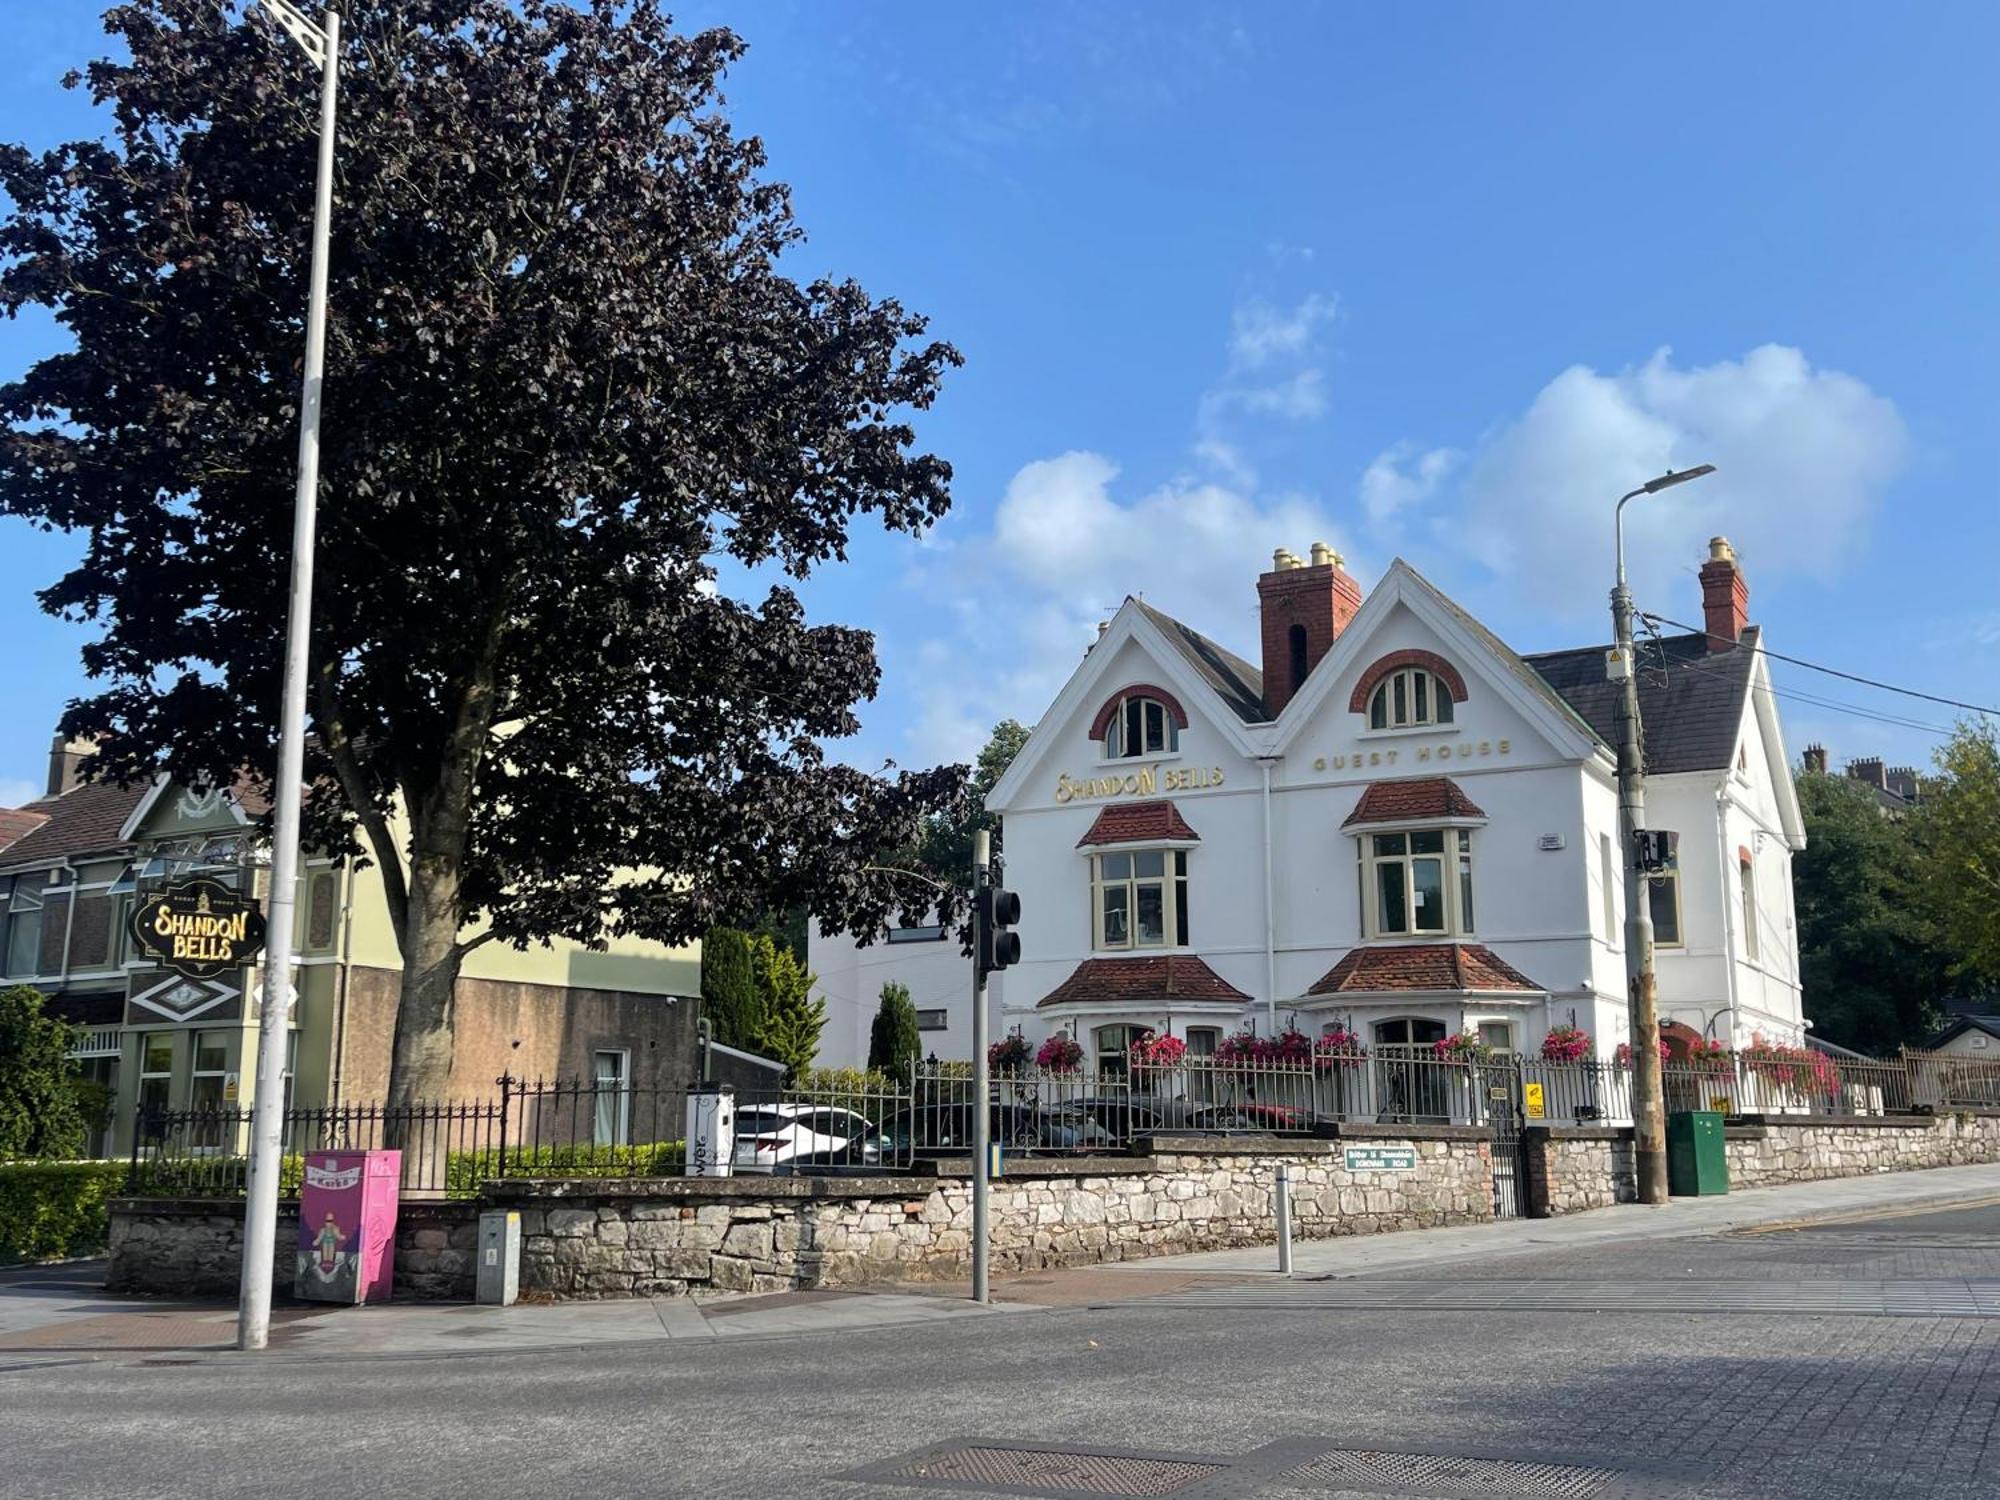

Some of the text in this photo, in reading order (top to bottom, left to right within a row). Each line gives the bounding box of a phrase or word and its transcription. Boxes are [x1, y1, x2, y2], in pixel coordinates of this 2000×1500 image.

[1313, 740, 1511, 772] GUEST HOUSE
[1056, 763, 1224, 803] SHANDON BELLS
[154, 904, 249, 942] SHANDON
[172, 935, 233, 961] BELLS
